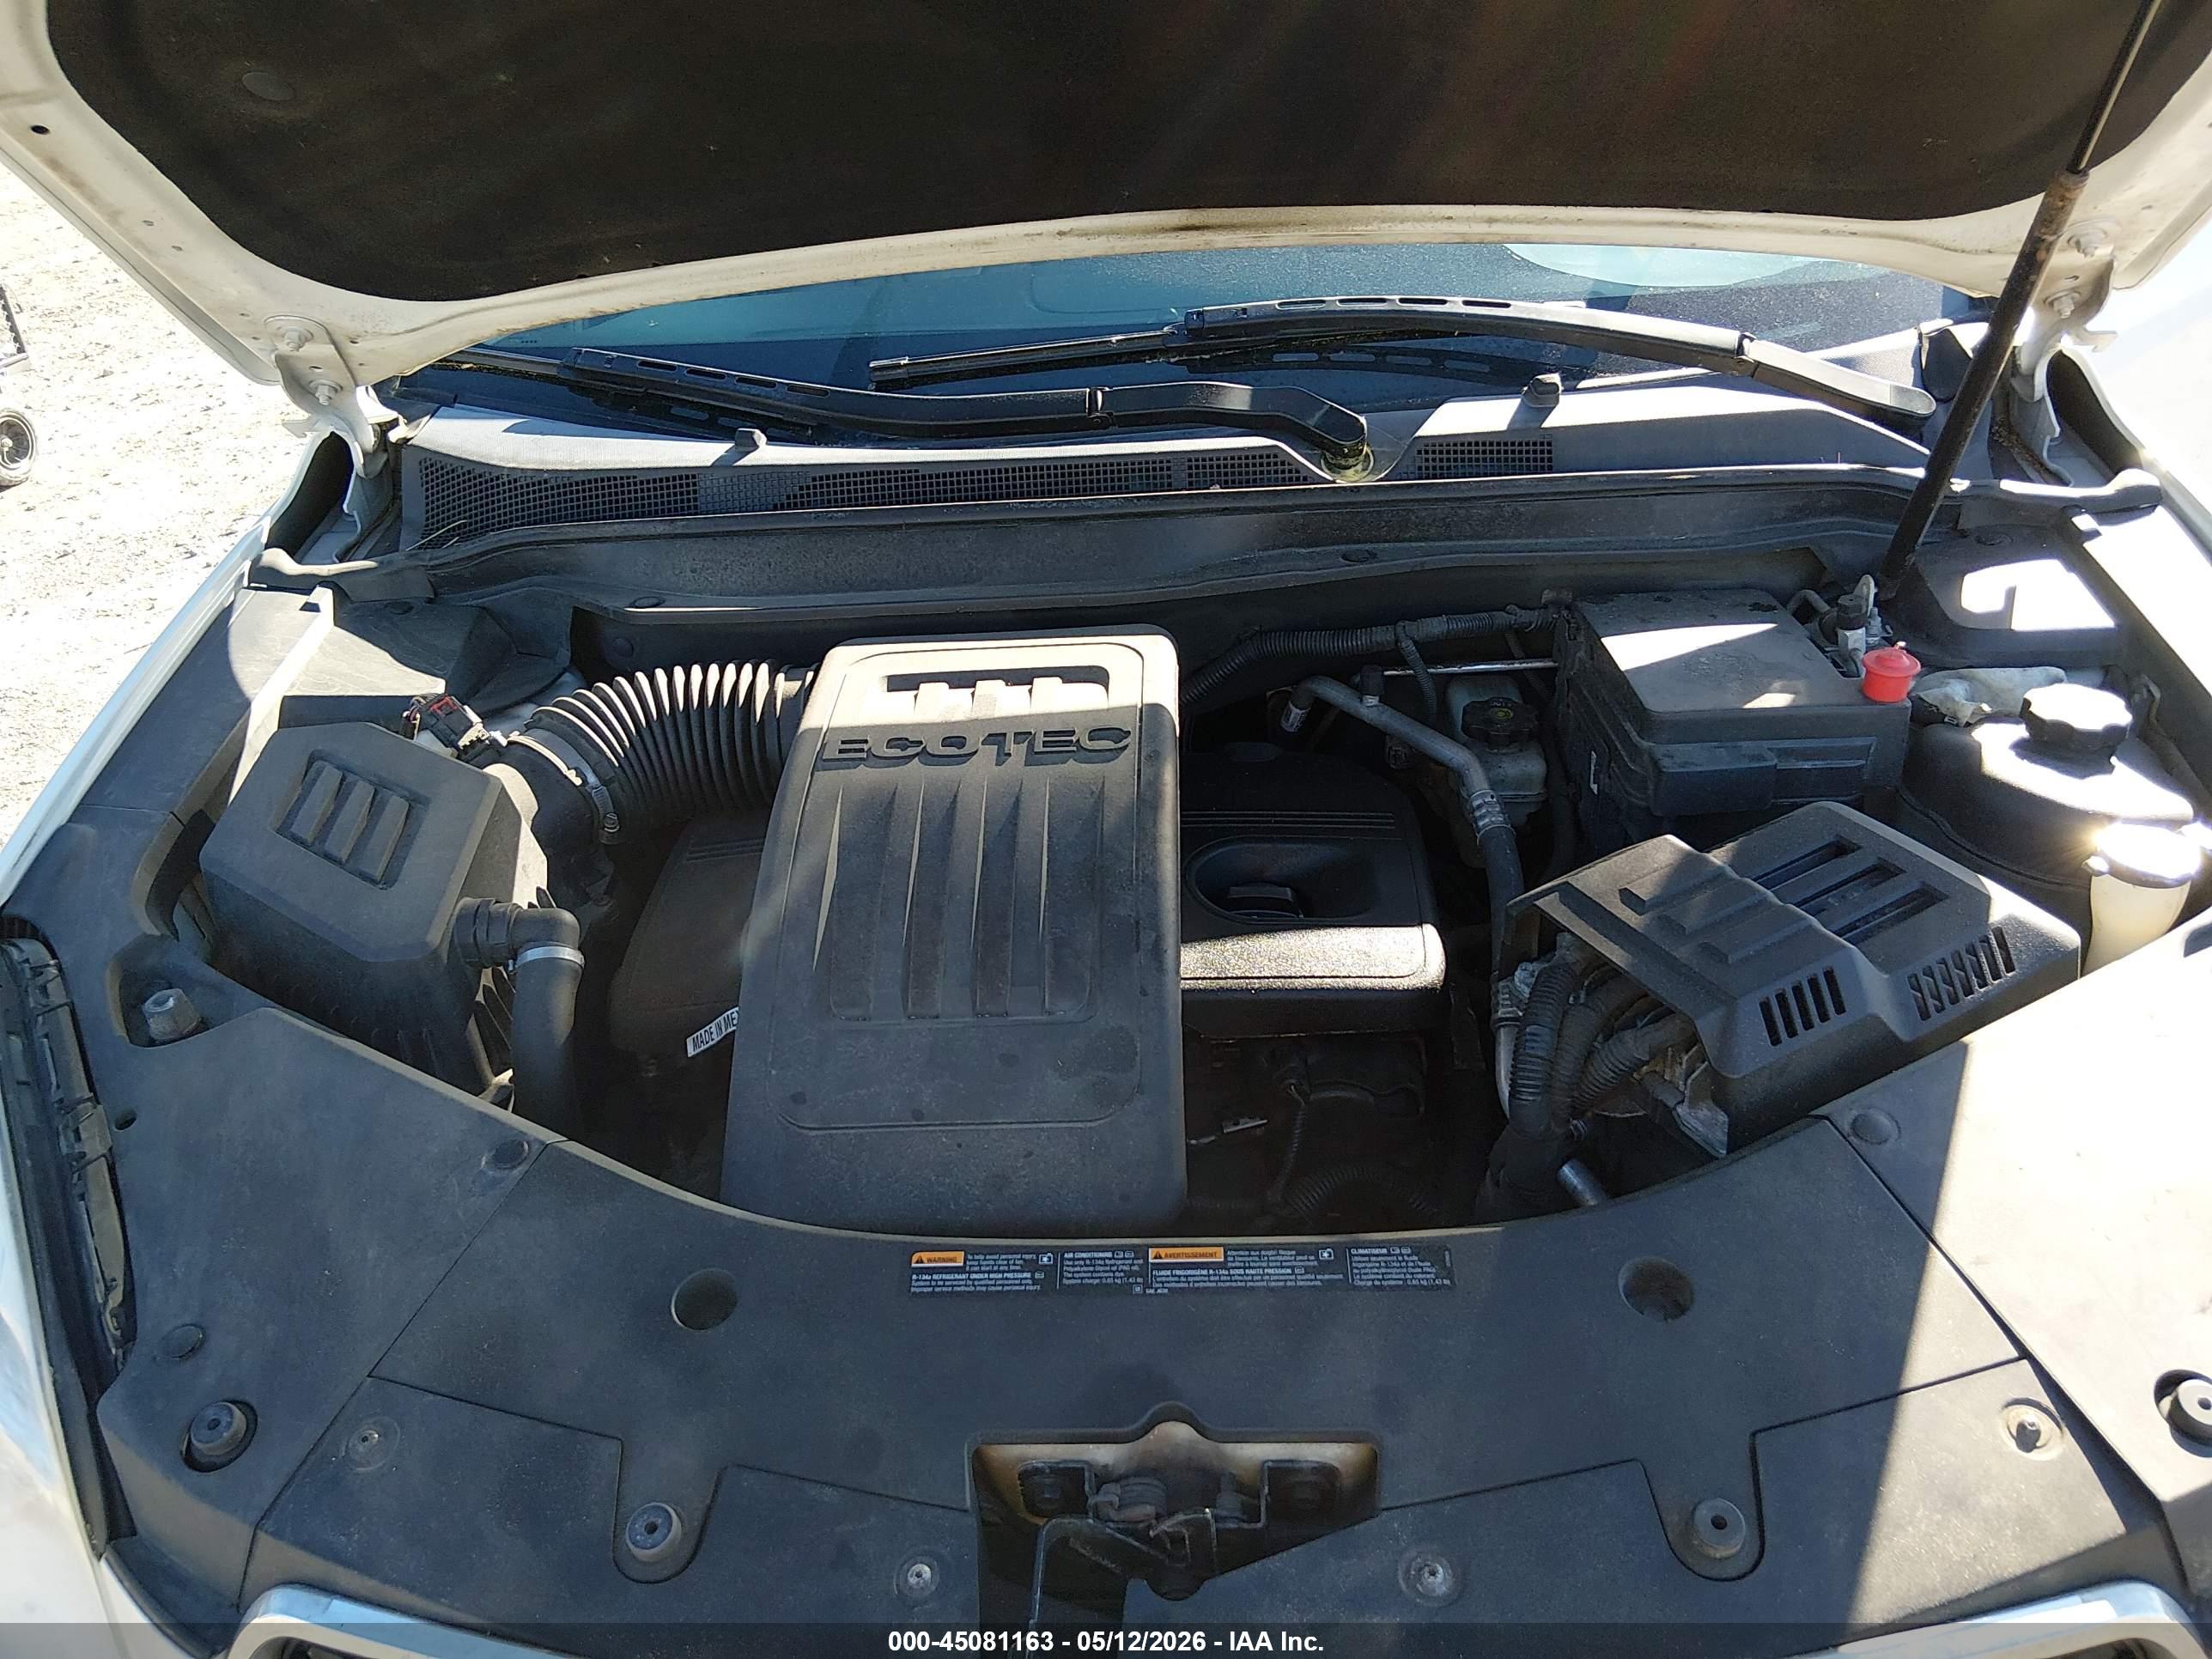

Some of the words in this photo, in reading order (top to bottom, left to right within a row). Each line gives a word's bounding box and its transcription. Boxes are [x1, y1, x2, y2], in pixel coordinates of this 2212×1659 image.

[819, 725, 1132, 771] ECOTEC
[692, 1026, 714, 1053] MADE
[714, 1019, 723, 1038] IN
